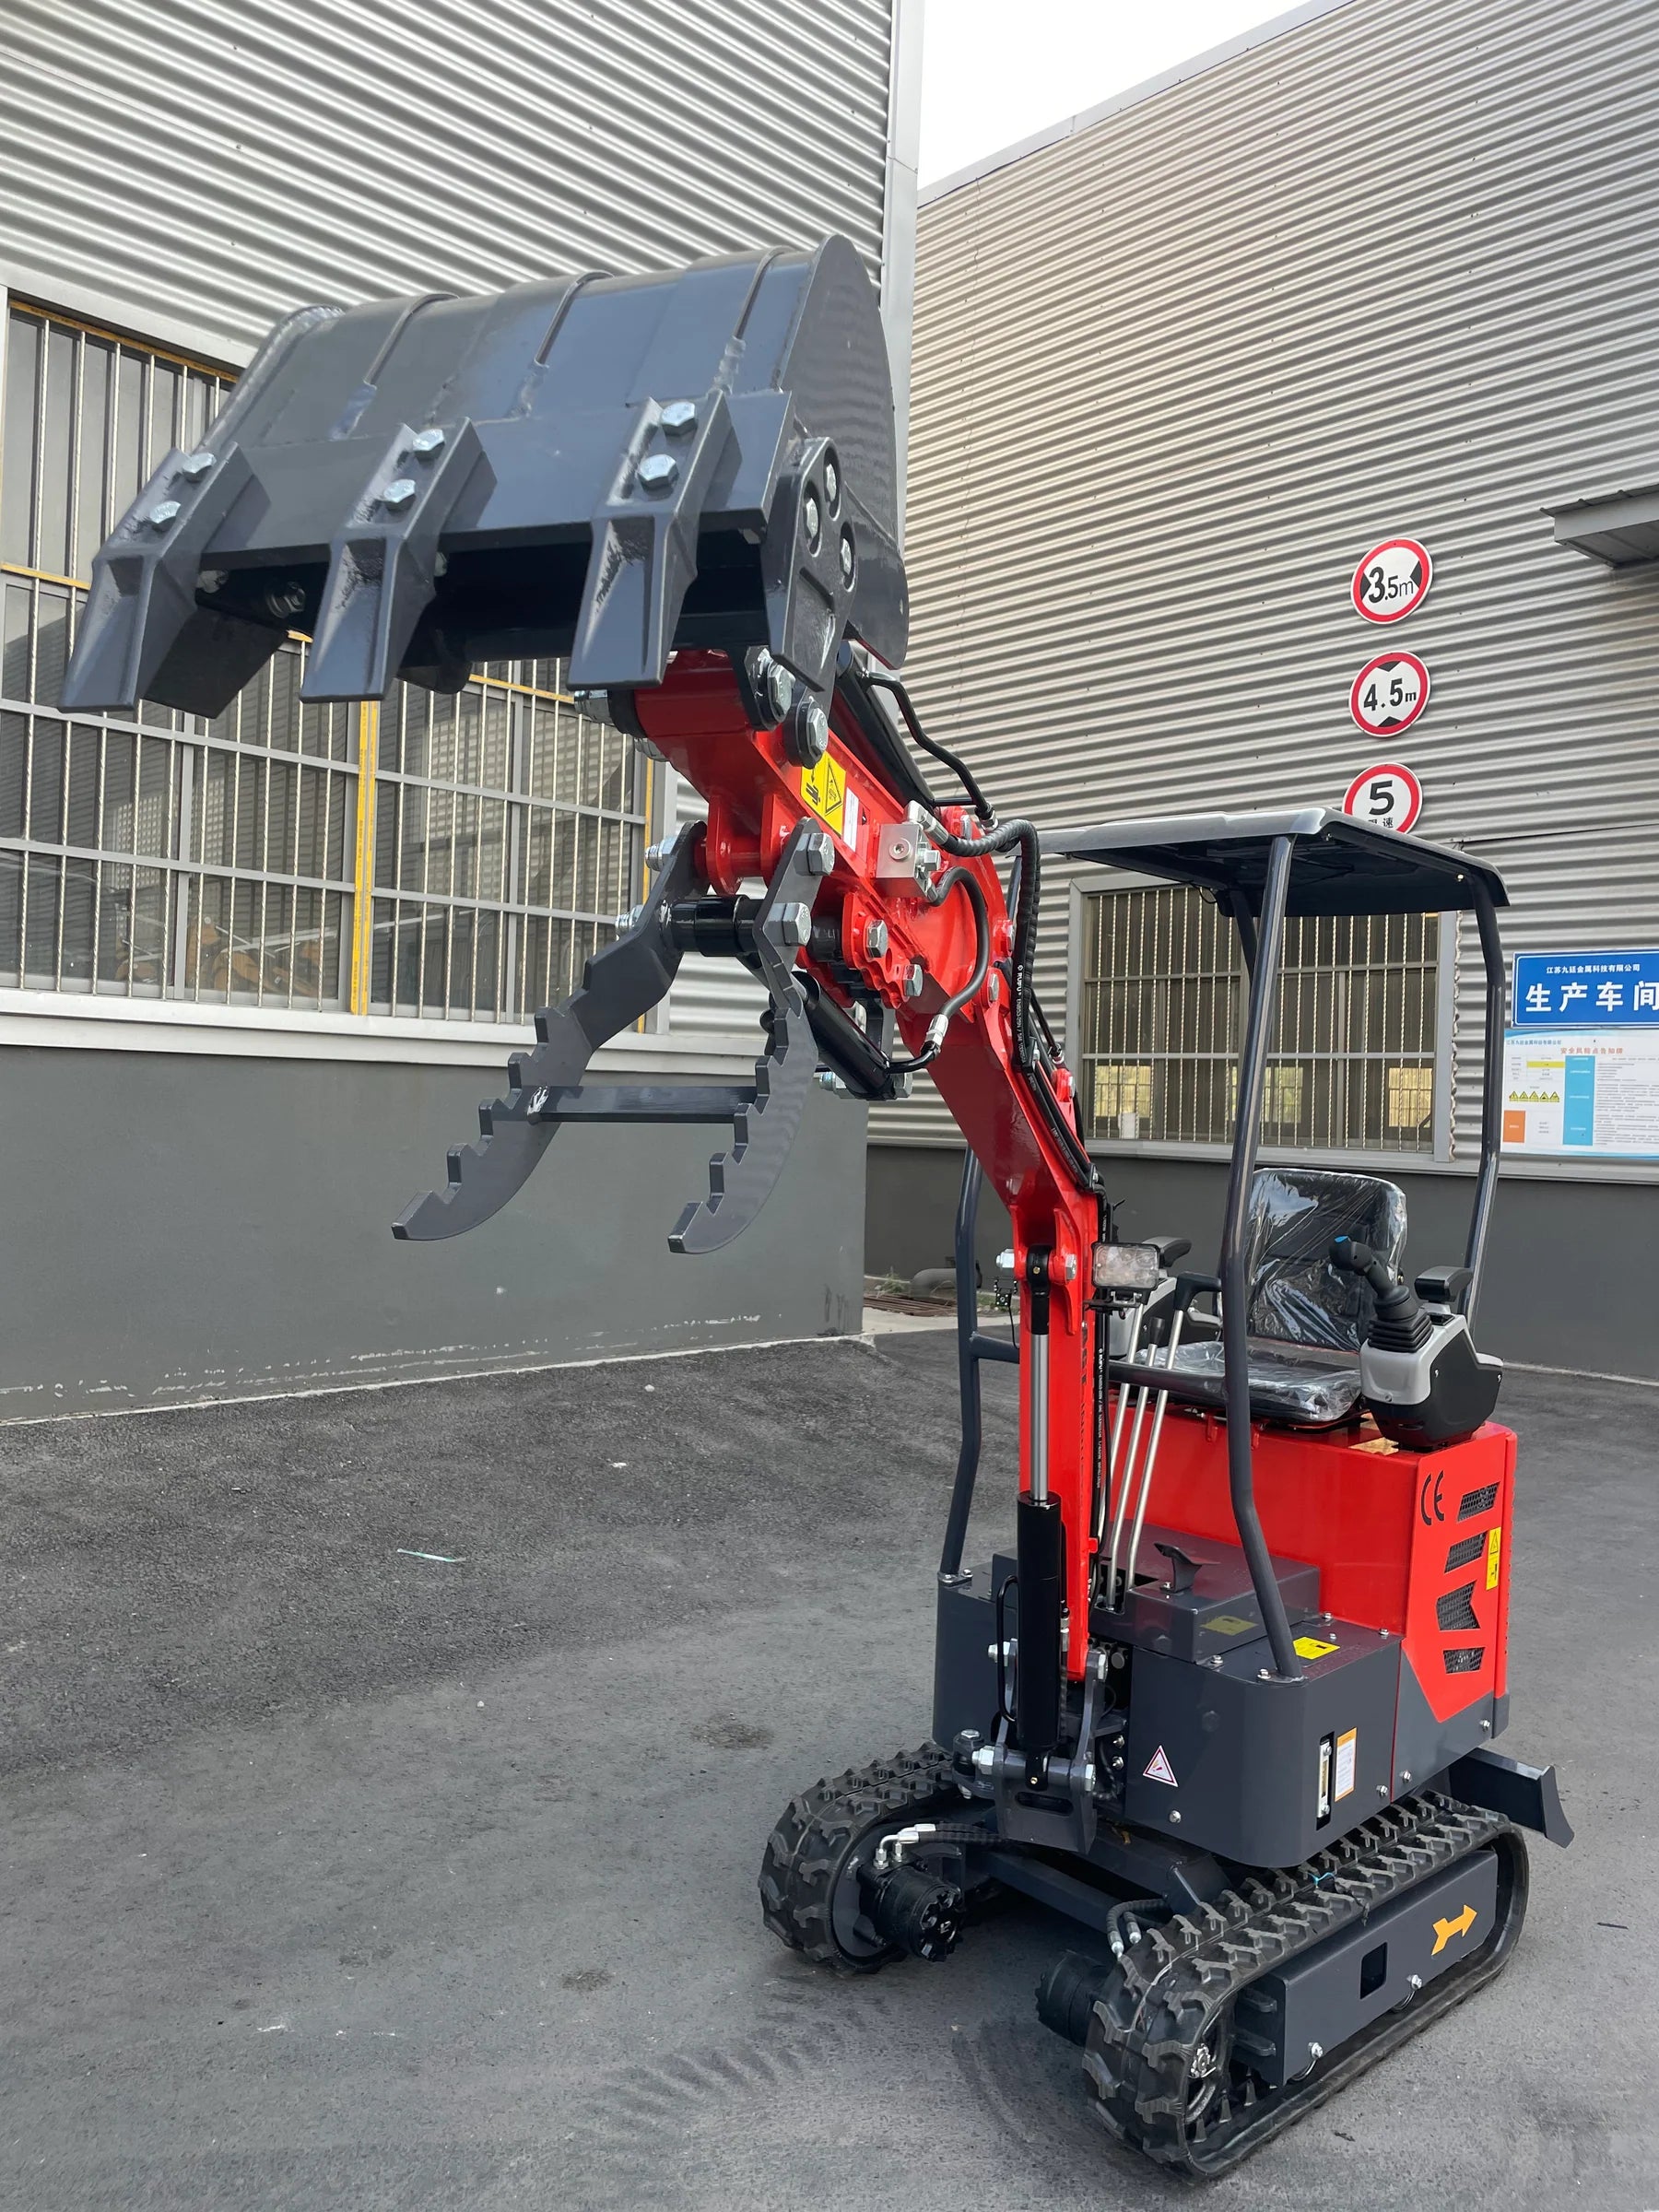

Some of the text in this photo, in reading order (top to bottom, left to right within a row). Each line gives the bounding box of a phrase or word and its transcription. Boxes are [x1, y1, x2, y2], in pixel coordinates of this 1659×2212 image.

[1369, 567, 1414, 603] 3.5m
[1364, 677, 1417, 711] 4.5m
[1369, 780, 1394, 816] 5
[1525, 980, 1659, 1013] 生产车间
[1420, 1471, 1444, 1525] CE
